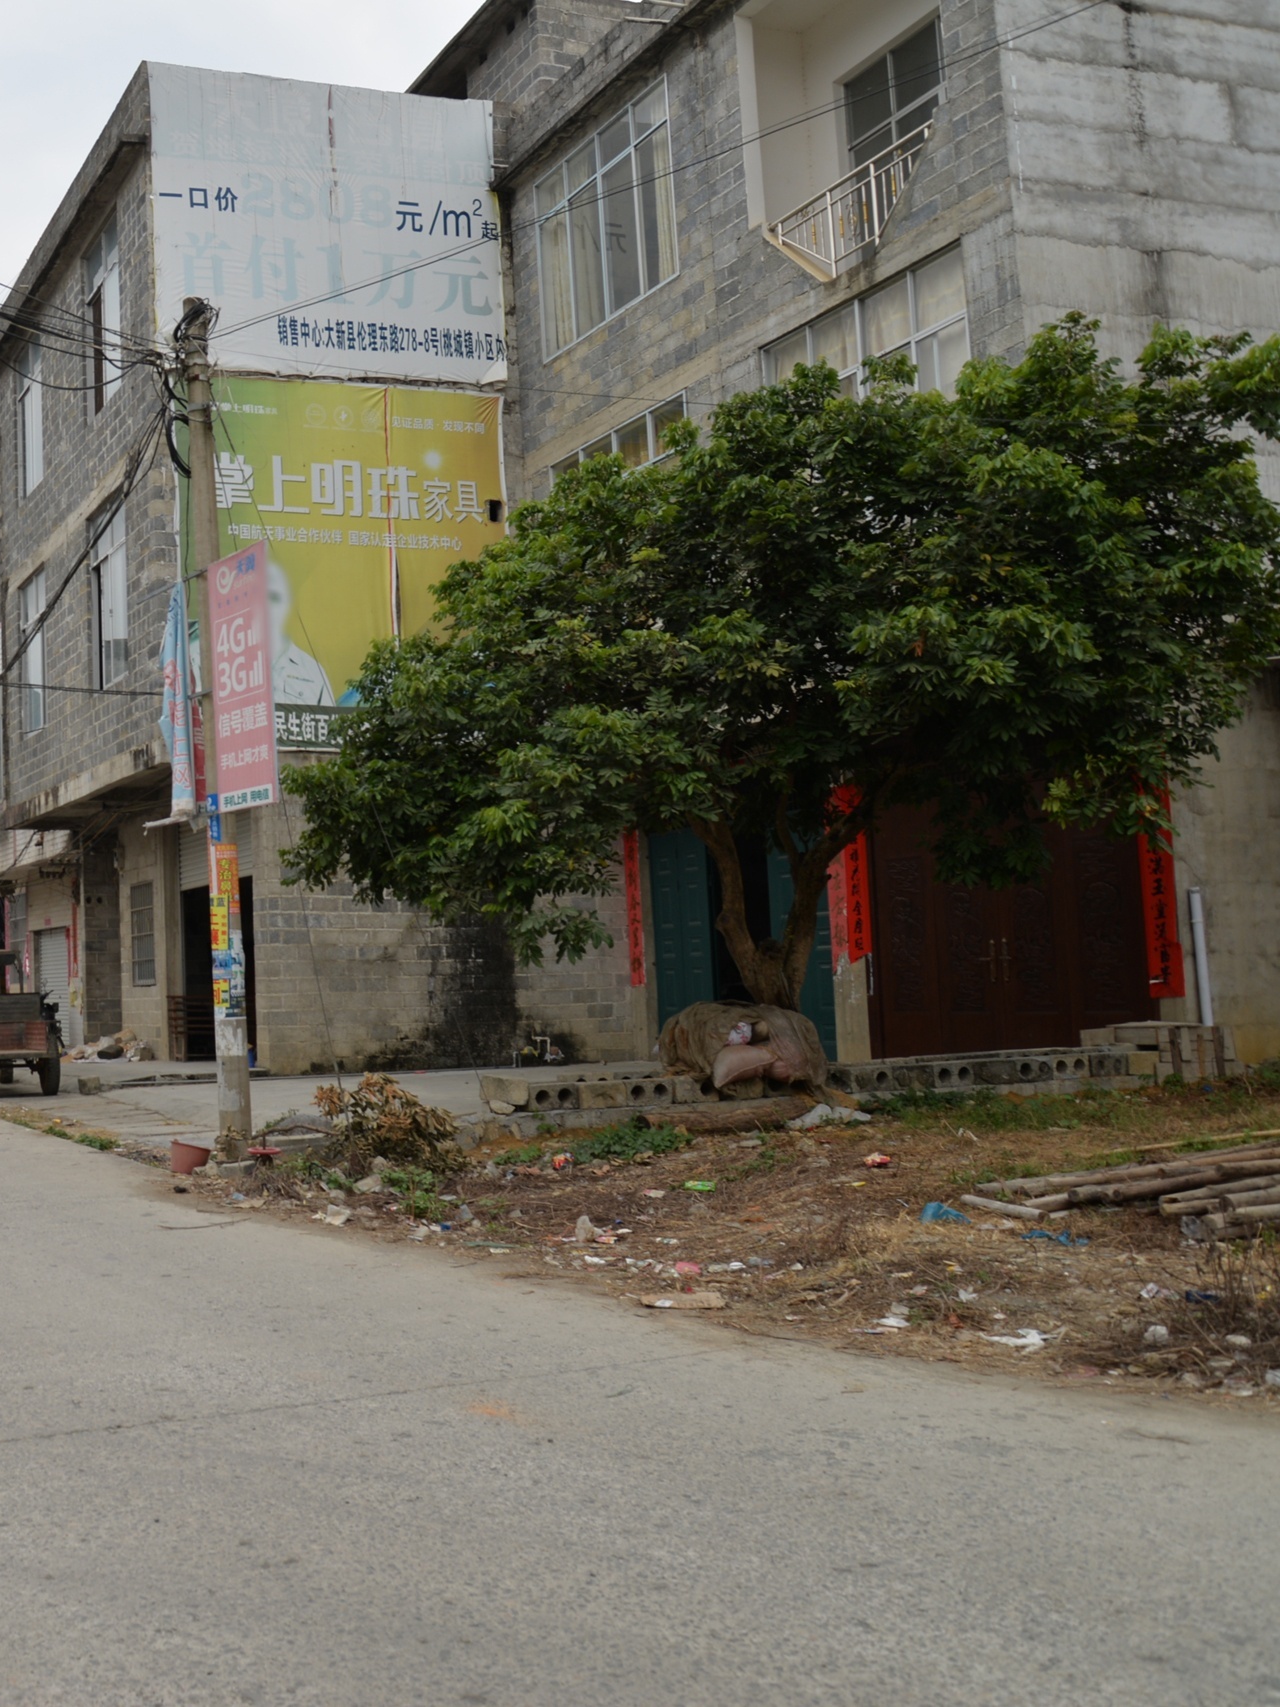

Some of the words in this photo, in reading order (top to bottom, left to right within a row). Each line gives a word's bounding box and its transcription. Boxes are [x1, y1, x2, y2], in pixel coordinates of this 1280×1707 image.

[159, 186, 238, 212] 一口价
[182, 232, 494, 316] 首付1万元
[228, 523, 343, 545] 中国航天事业合作伙伴
[348, 530, 463, 552] 国家认定企业技术中心
[217, 616, 247, 658] 4G
[218, 655, 248, 699] 3G
[218, 702, 269, 739] 信号覆盖
[220, 743, 269, 771] 手机上网才爽
[223, 790, 248, 808] 手机上网
